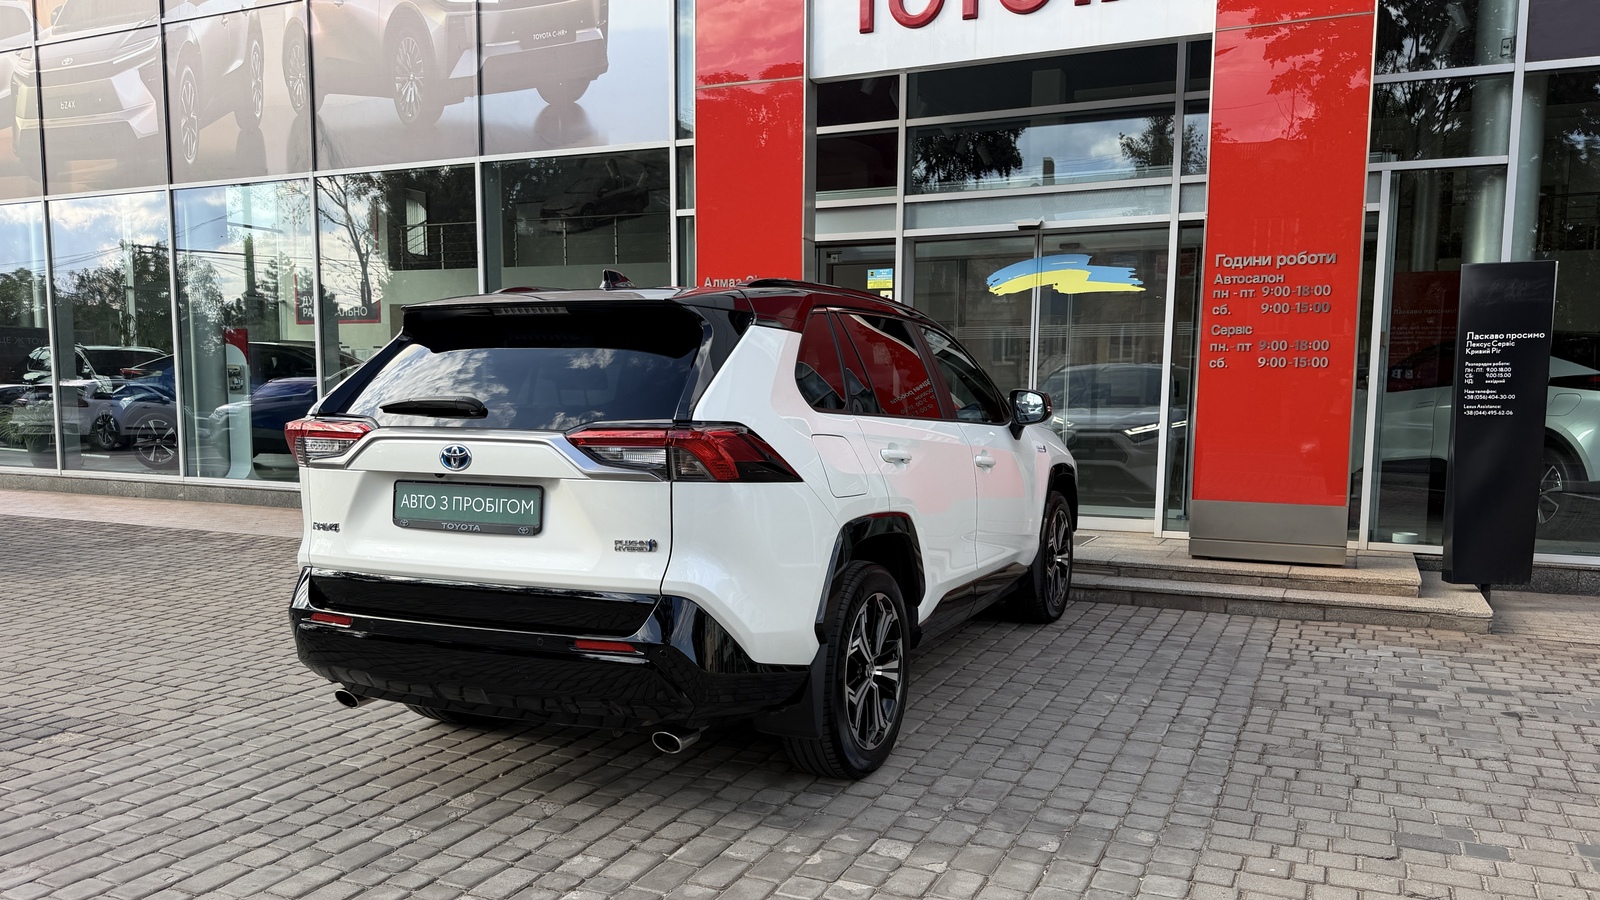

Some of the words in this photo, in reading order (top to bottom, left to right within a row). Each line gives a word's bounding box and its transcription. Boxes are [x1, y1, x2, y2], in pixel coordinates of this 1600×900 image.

[533, 31, 551, 40] TOYOTA
[1215, 253, 1272, 269] Години
[1275, 250, 1337, 269] роботи
[1213, 273, 1285, 285] Автосалон
[1211, 304, 1231, 315] сб.
[1211, 324, 1253, 337] Сервіс
[1466, 331, 1505, 341] Ласкаво
[1506, 332, 1546, 341] просимо
[1466, 340, 1491, 348] Лексус
[1465, 347, 1490, 355] Кривий
[1208, 357, 1228, 368] сб.
[400, 493, 437, 510] АВТО
[439, 495, 449, 511] З
[452, 496, 534, 515] ПРОБІГОМ
[441, 522, 481, 532] TOYOTA
